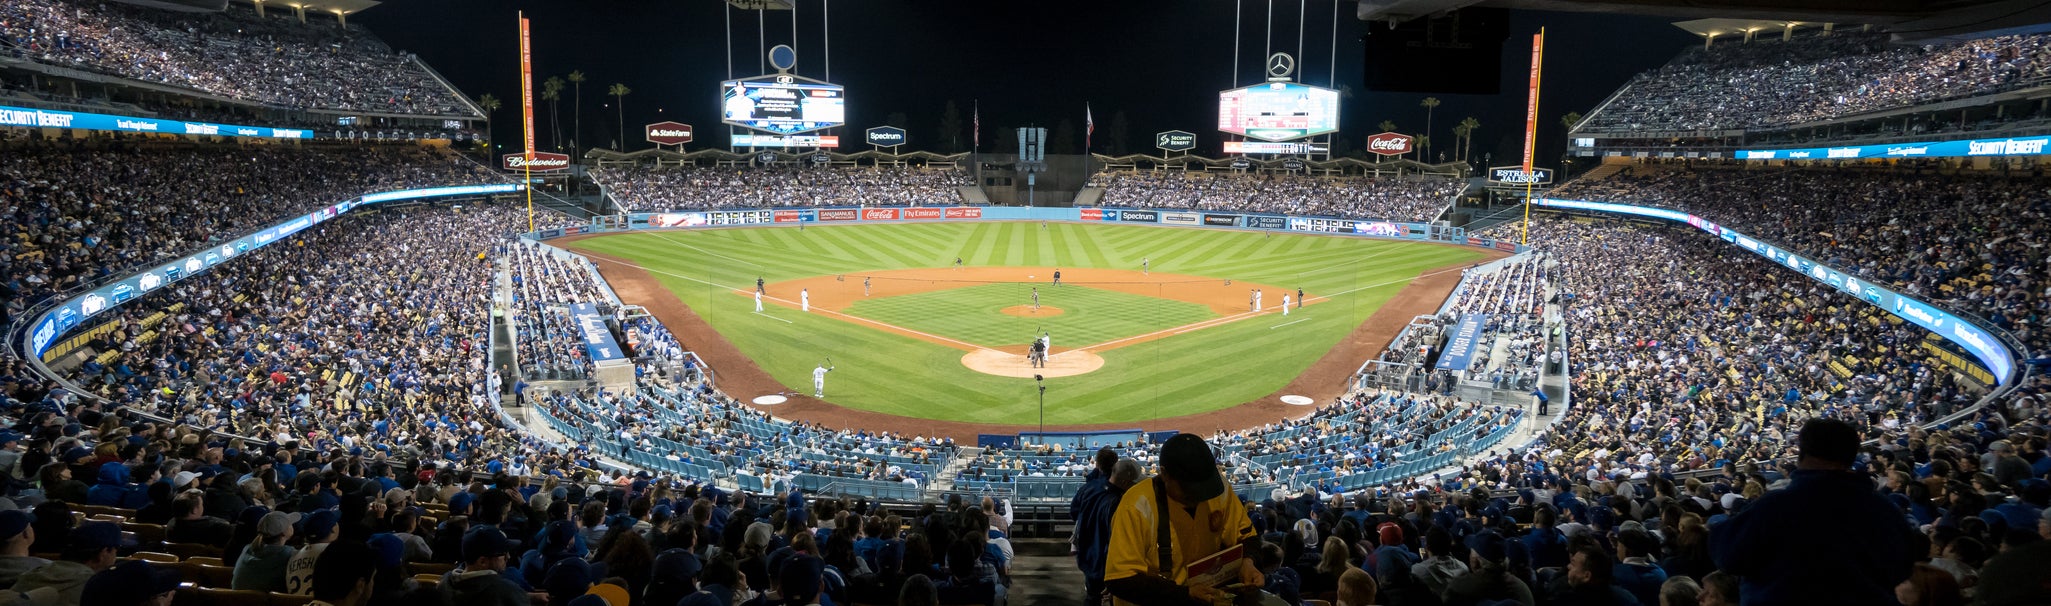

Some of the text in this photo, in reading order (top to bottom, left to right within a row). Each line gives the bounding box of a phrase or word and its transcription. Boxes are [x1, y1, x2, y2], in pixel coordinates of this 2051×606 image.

[37, 110, 73, 127] BENEFIT
[870, 132, 901, 140] Spectrum
[507, 156, 567, 167] Budweiser
[1496, 169, 1544, 178] ESTRELA
[904, 209, 915, 218] Fly
[915, 208, 940, 217] Emirates
[1122, 211, 1154, 221] Spectrum
